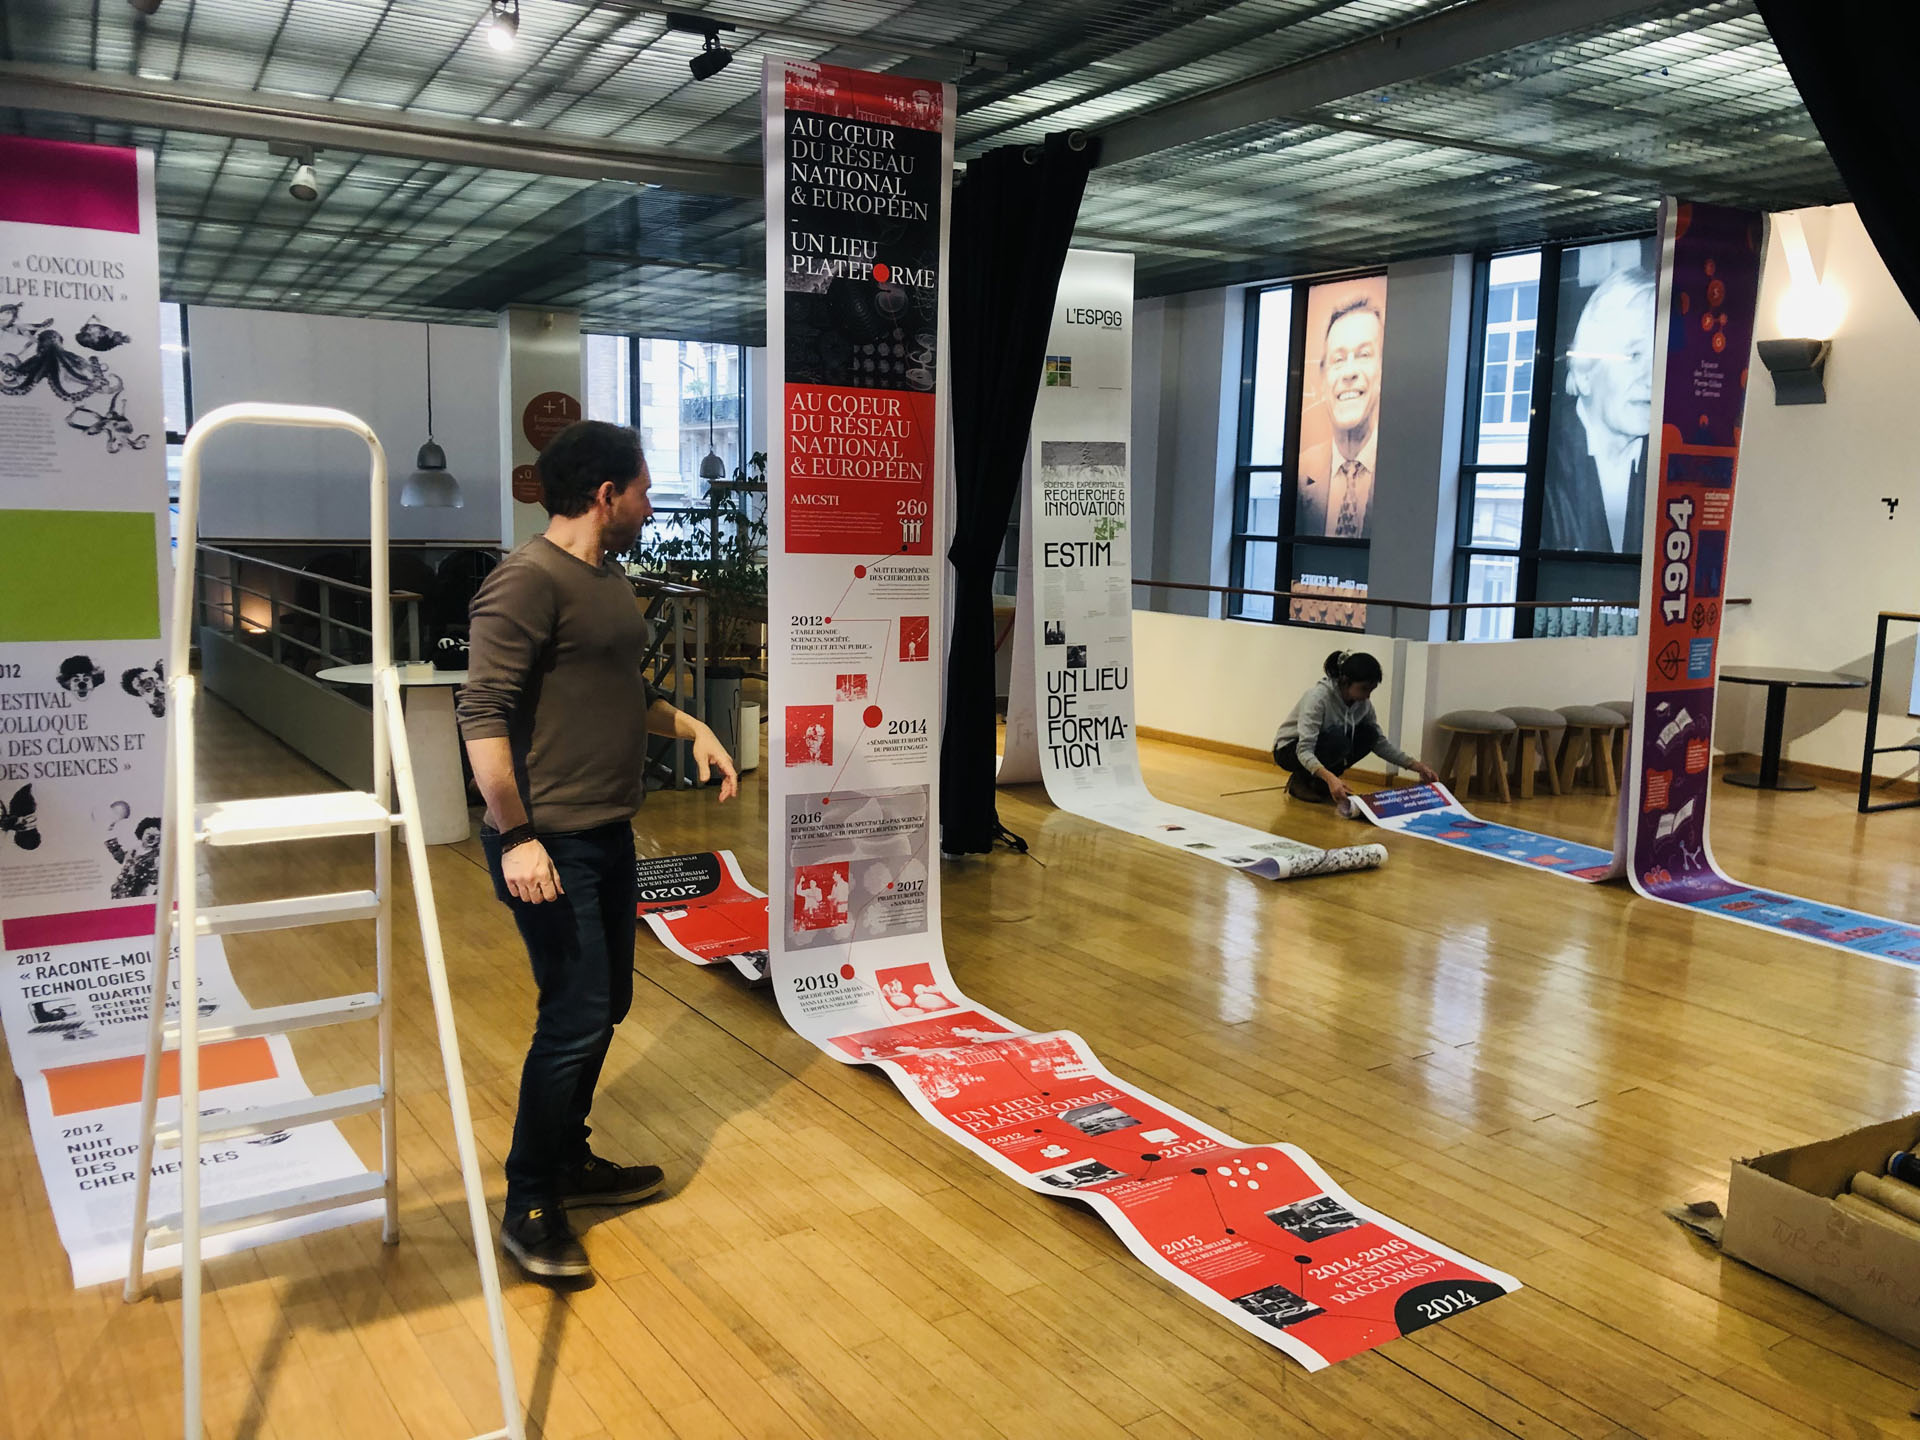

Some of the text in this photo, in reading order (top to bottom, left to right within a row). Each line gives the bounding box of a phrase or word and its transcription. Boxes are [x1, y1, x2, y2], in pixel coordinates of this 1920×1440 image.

[791, 117, 824, 138] AU
[792, 139, 915, 175] DU RÉSEAU
[791, 162, 907, 196] NATIONAL
[791, 186, 929, 221] & EUROPÉEN
[791, 231, 878, 260] UN LIEU
[26, 254, 125, 280] CONCOURS
[0, 275, 115, 302] LPE FICTION
[1066, 308, 1122, 327] L'ESPGG
[790, 392, 823, 411] AU
[791, 413, 911, 438] DU RÉSEAU
[790, 435, 903, 459] NATIONAL
[791, 456, 923, 480] & EUROPÉEN
[791, 494, 840, 506] AMCSTI
[1044, 489, 1116, 501] RECHERCHE
[896, 499, 928, 516] 260
[1044, 501, 1125, 516] INNOVATION
[1044, 541, 1111, 567] ESTIM
[1663, 499, 1693, 622] 1994
[791, 616, 823, 626] 2012
[0, 664, 21, 678] 012
[1047, 667, 1128, 694] UN LIEU
[0, 691, 72, 711] ESTIVAL
[1048, 694, 1077, 720] DE
[888, 719, 927, 735] 2014
[1048, 716, 1128, 745] FORMA-
[9, 733, 145, 757] DES CLOWNS ET
[1048, 742, 1101, 769] TION
[0, 758, 118, 781] DES SCIENCES
[791, 812, 822, 825] 2016
[641, 885, 700, 900] 2020
[897, 880, 924, 892] 2017
[17, 952, 51, 966] 2012
[36, 951, 152, 980] RACONTE-MOI
[21, 970, 146, 999] TECHNOLOGIES
[793, 973, 839, 992] 2019
[951, 1095, 1045, 1124] UN LIEU
[966, 1089, 1120, 1132] PLATEFORME
[62, 1123, 104, 1139] 2012
[988, 1132, 1025, 1145] 2012
[67, 1137, 113, 1153] NUIT
[1158, 1138, 1218, 1159] 2012
[75, 1161, 117, 1178] DES
[1161, 1235, 1203, 1255] 2013
[1308, 1239, 1408, 1280] 2014-2016
[1344, 1250, 1430, 1284] FESTIVAL
[1329, 1263, 1437, 1305] RACCOR(S)
[1417, 1289, 1481, 1320] 2014
